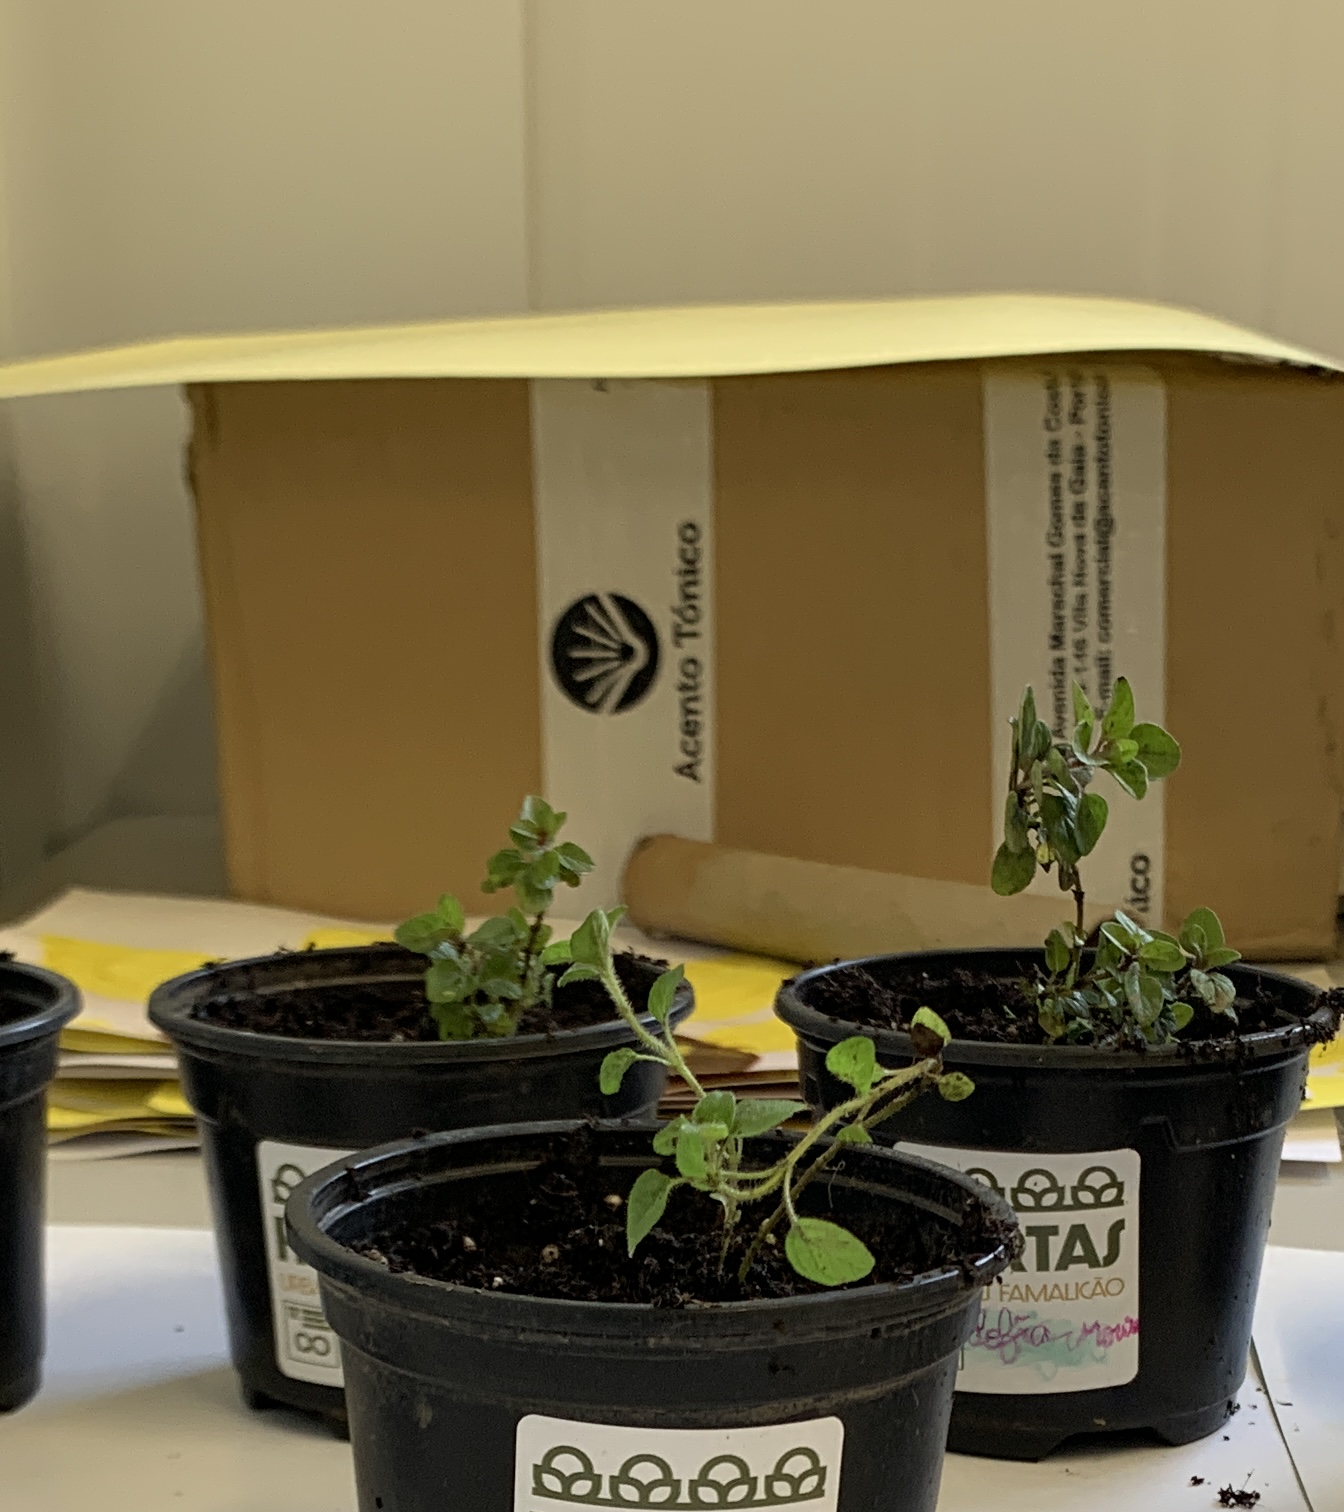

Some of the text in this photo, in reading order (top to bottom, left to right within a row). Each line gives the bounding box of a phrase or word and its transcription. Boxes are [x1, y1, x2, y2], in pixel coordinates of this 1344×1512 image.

[670, 521, 703, 783] Acento Tónico
[1000, 1277, 1125, 1303] FAMALICÃO
